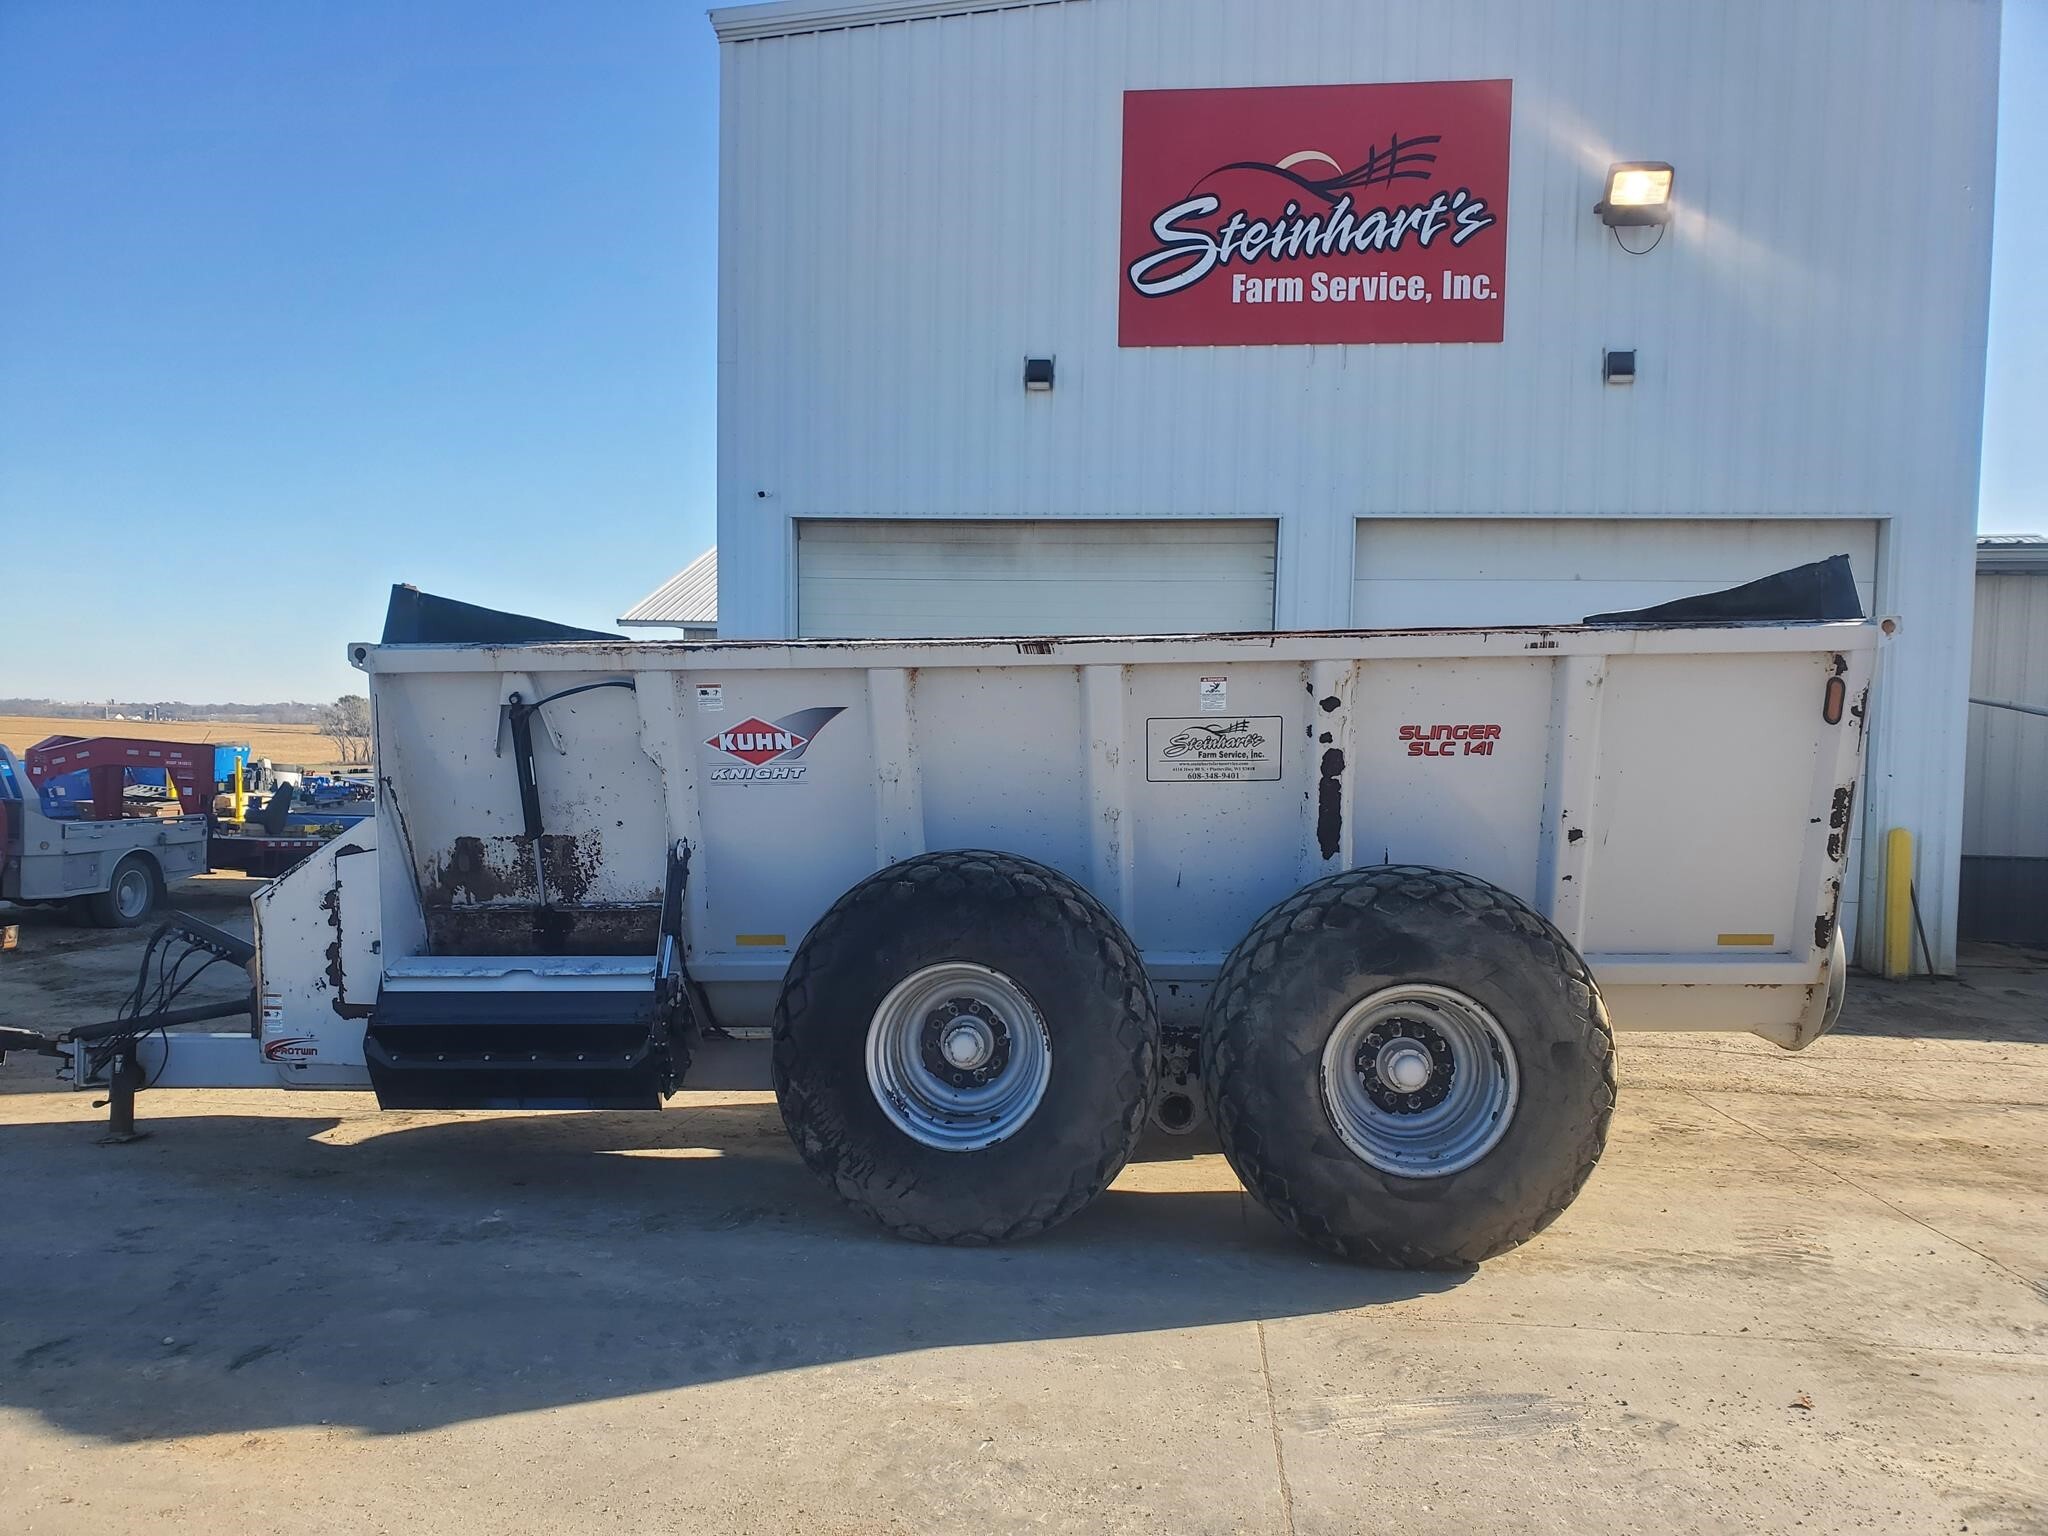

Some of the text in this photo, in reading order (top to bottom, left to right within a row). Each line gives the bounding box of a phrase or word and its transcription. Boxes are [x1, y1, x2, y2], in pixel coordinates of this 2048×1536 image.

[1128, 188, 1496, 297] Steinhart's
[1232, 270, 1497, 303] Farm Service, Inc.
[1399, 725, 1501, 740] SLINGER
[718, 732, 793, 751] KUHN
[1163, 733, 1265, 758] Steinhart's
[1408, 741, 1493, 756] SLC 141
[1197, 749, 1265, 760] Farm Service, Inc.
[711, 768, 806, 780] KNIGHT
[274, 1047, 318, 1056] PROTWIN
